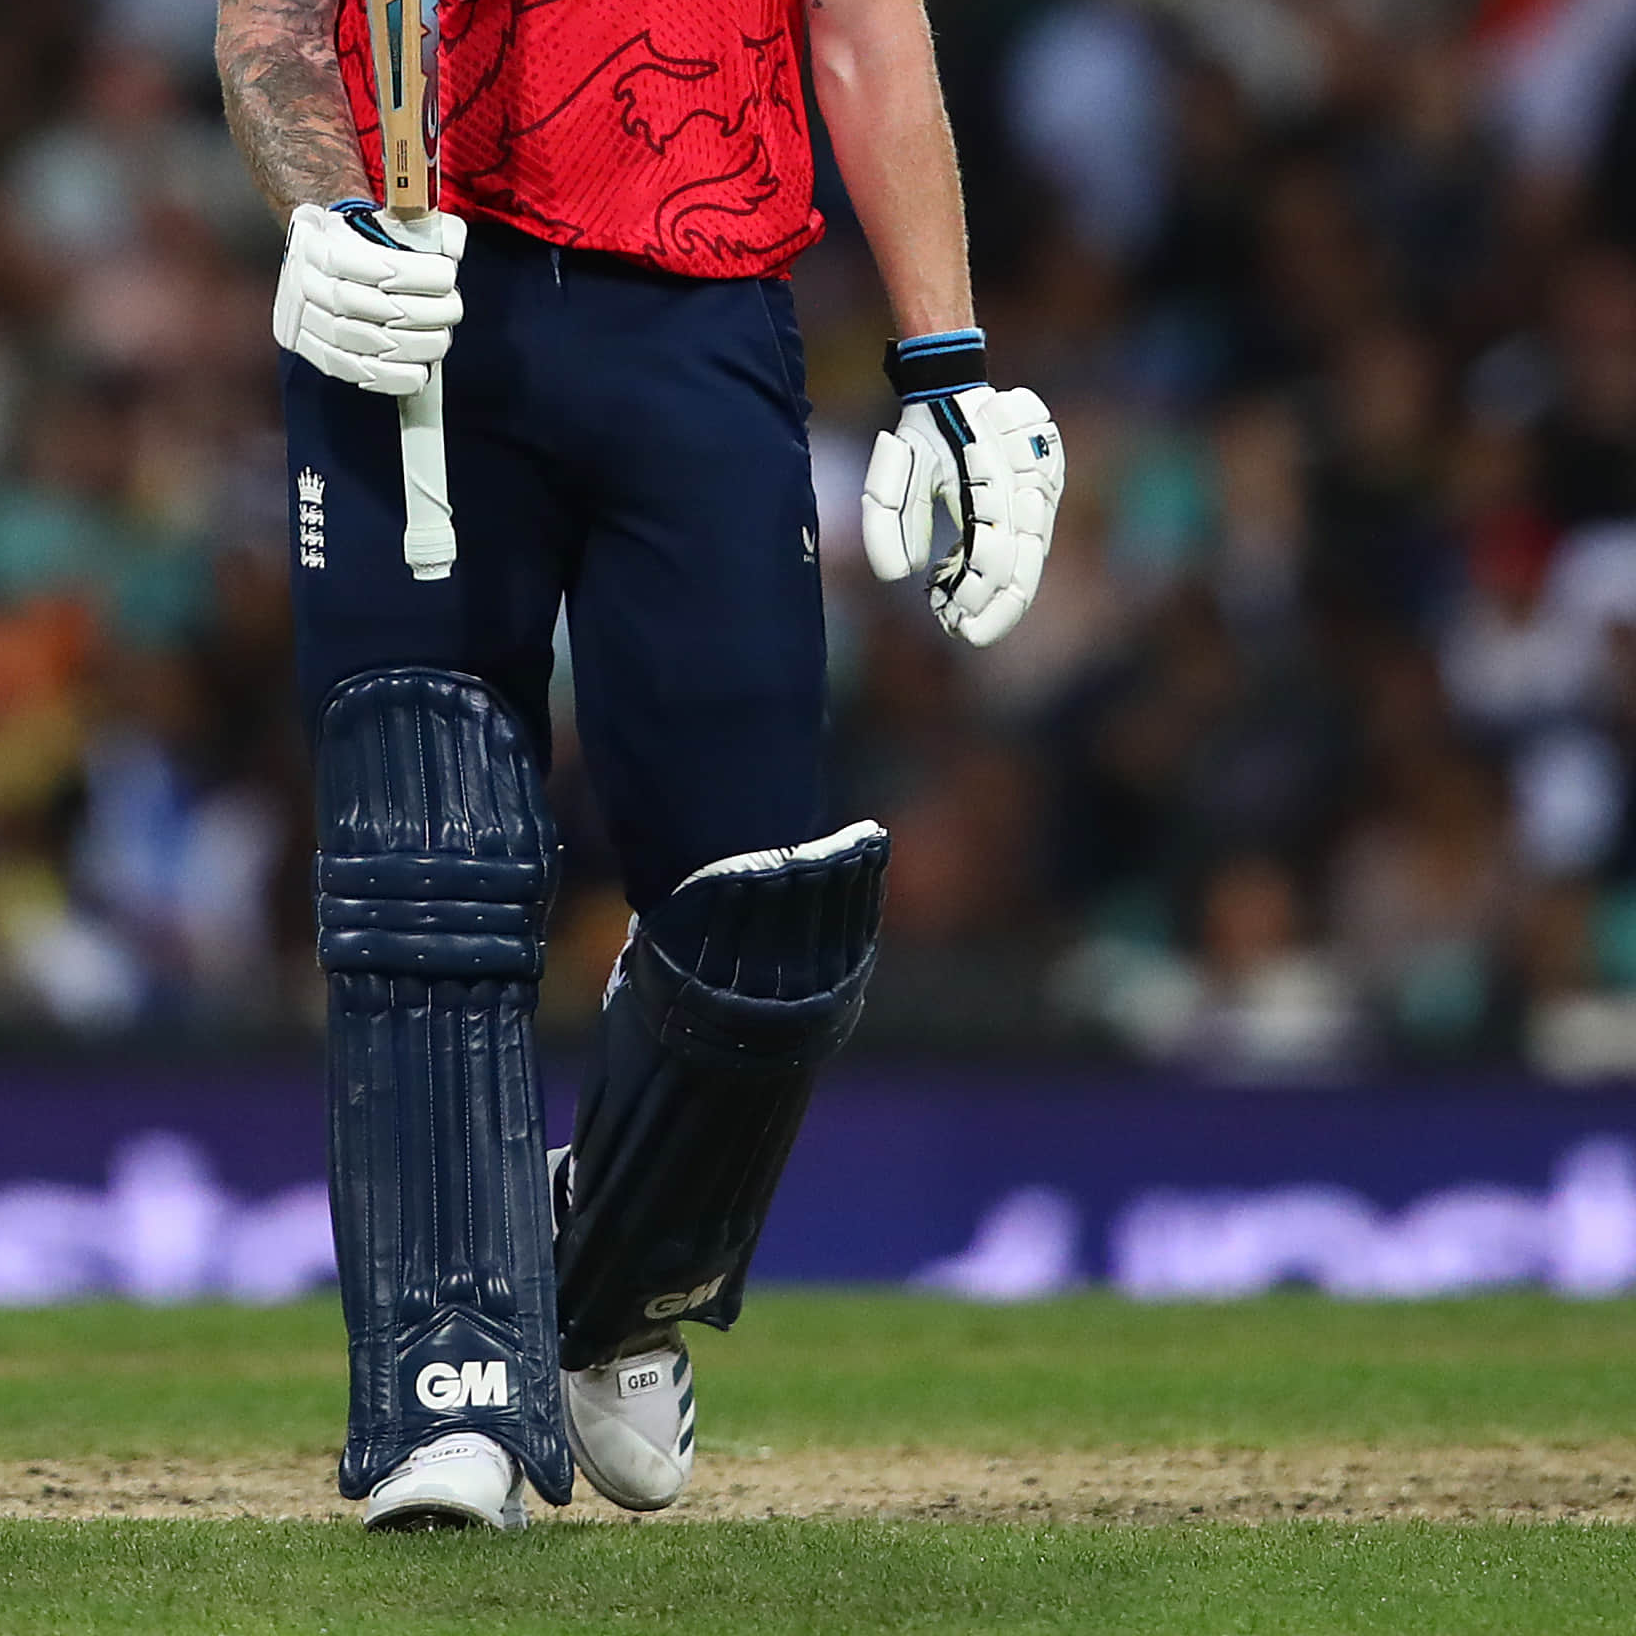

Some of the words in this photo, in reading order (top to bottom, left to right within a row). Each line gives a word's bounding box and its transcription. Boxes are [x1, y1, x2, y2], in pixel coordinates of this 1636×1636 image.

[643, 1273, 726, 1320] GM
[415, 1360, 509, 1411] GM
[628, 1371, 659, 1390] GED
